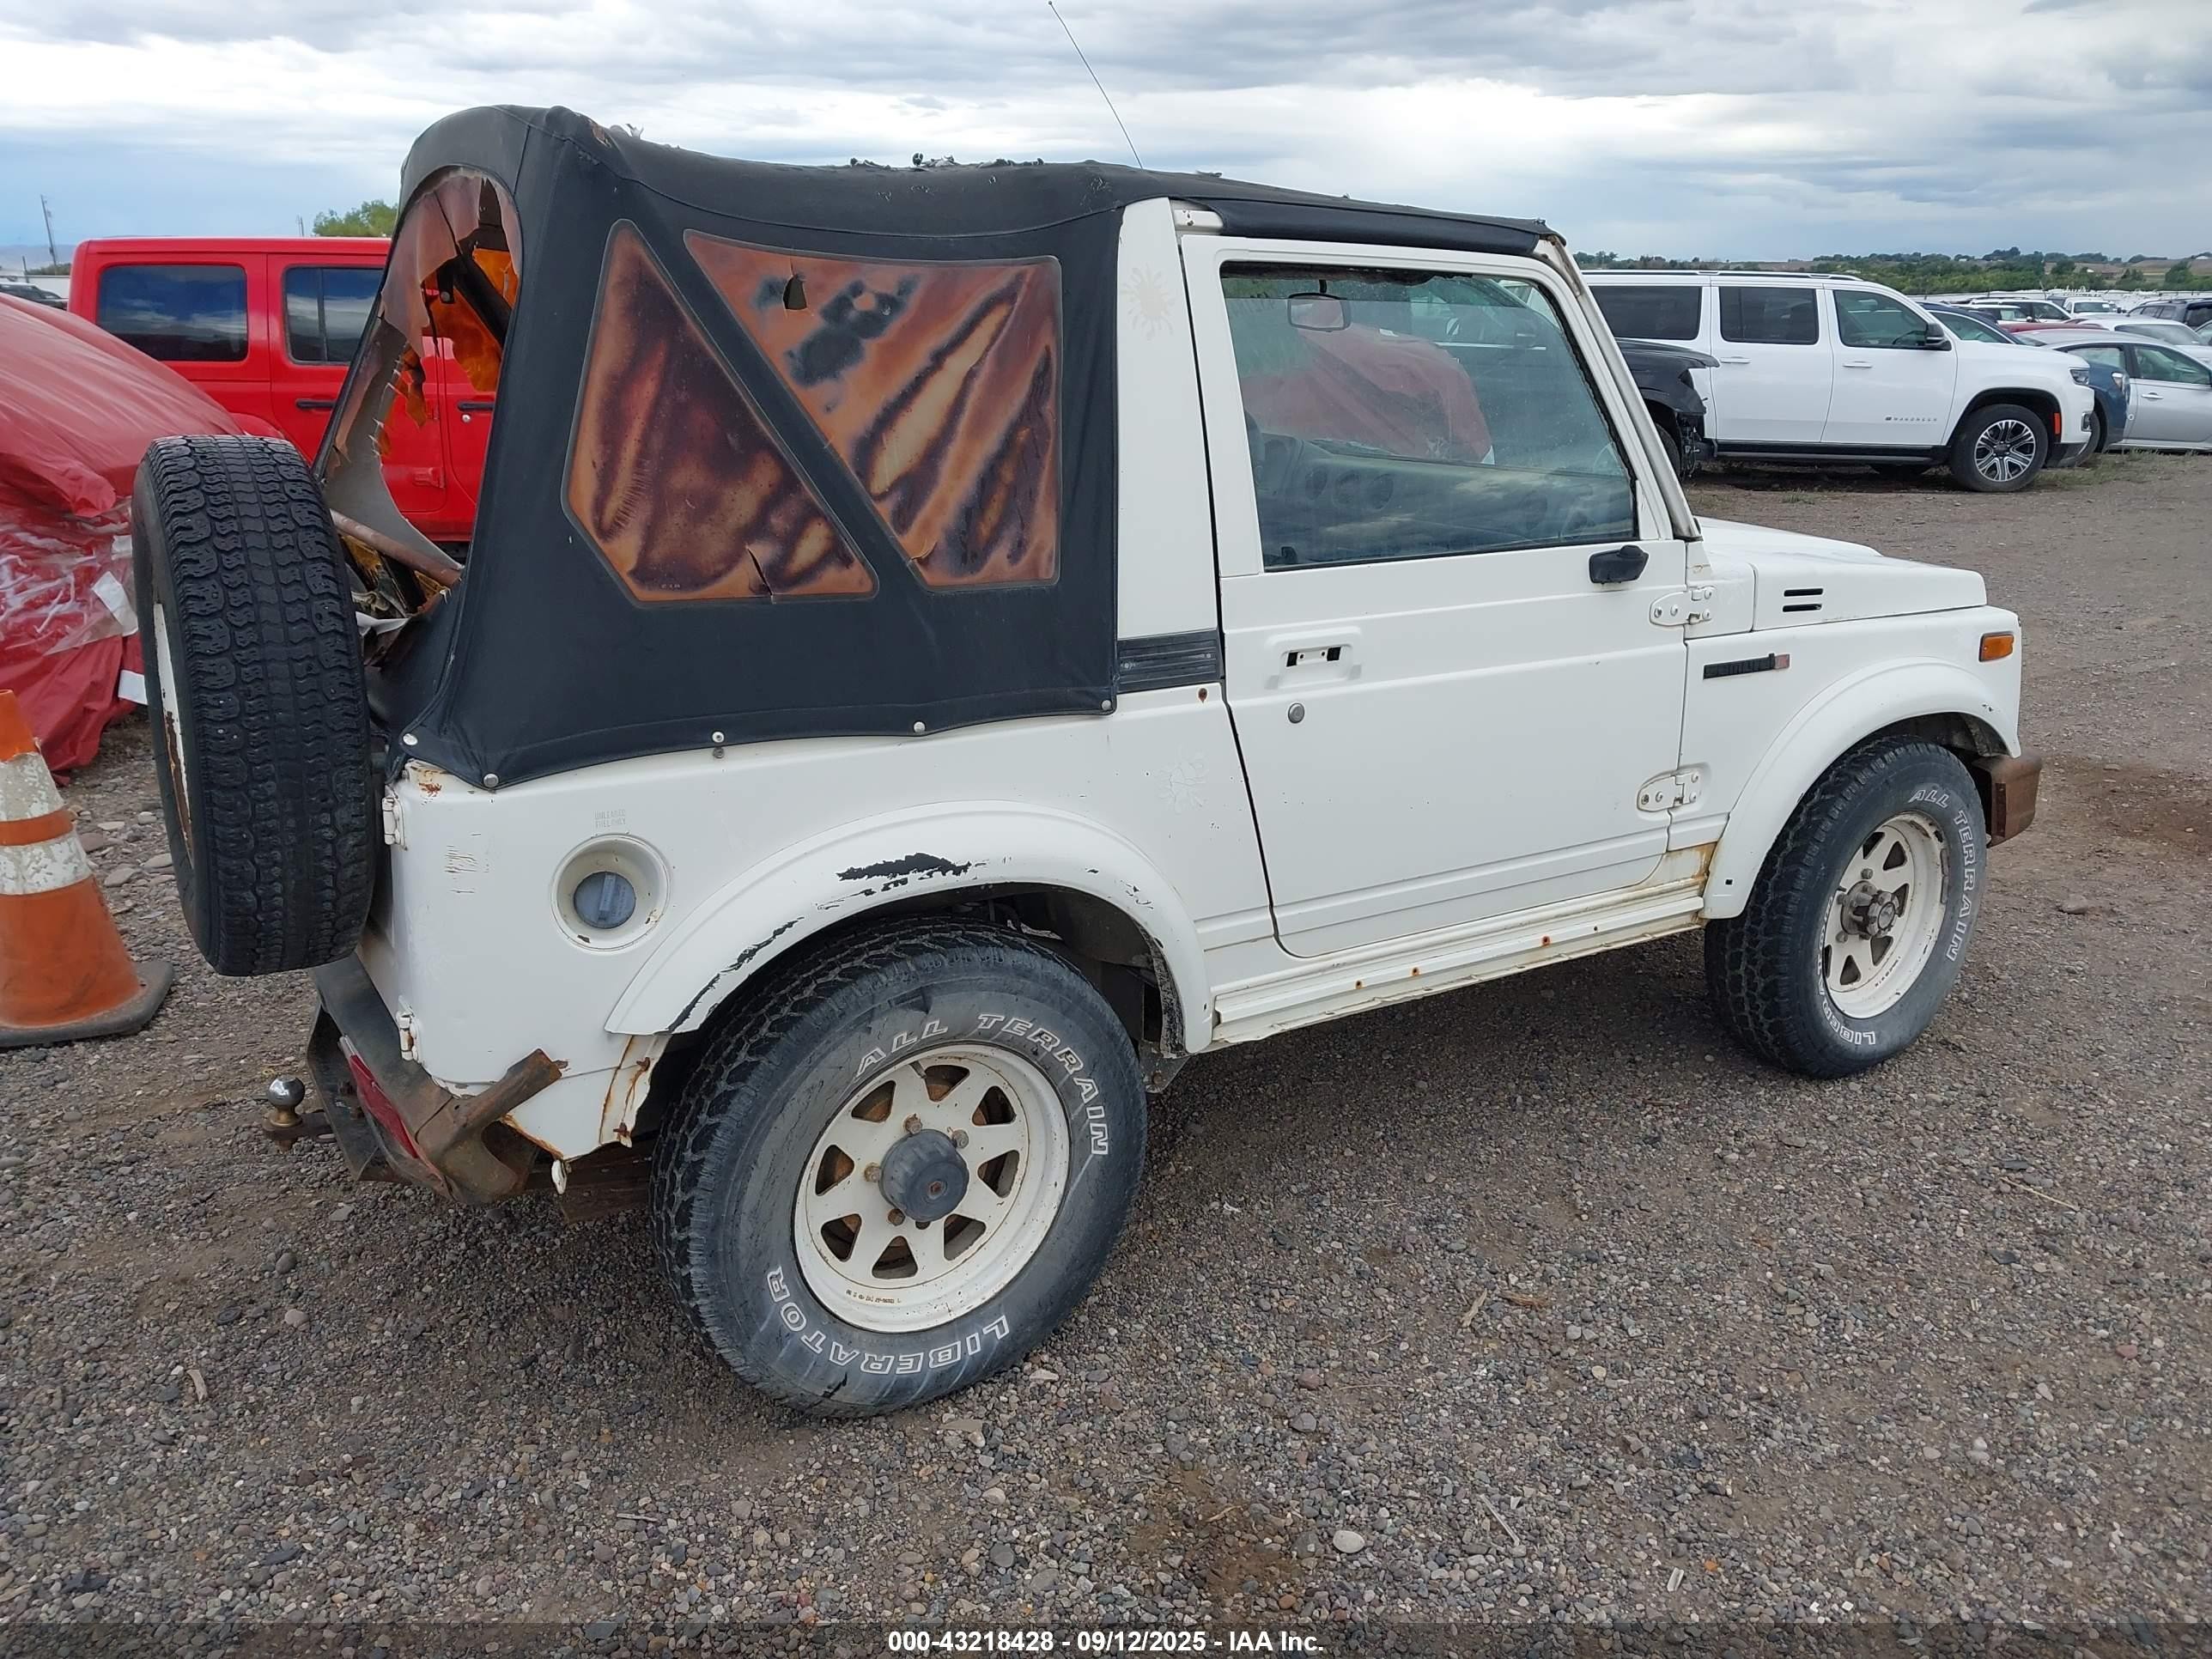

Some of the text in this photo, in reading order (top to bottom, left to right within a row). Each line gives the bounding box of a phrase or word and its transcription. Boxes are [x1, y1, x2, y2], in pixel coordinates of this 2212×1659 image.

[1908, 789, 1977, 962] ALL TERRAIN
[854, 1013, 1109, 1155] ALL TERRAIN
[767, 1267, 1010, 1375] LIBERATOR
